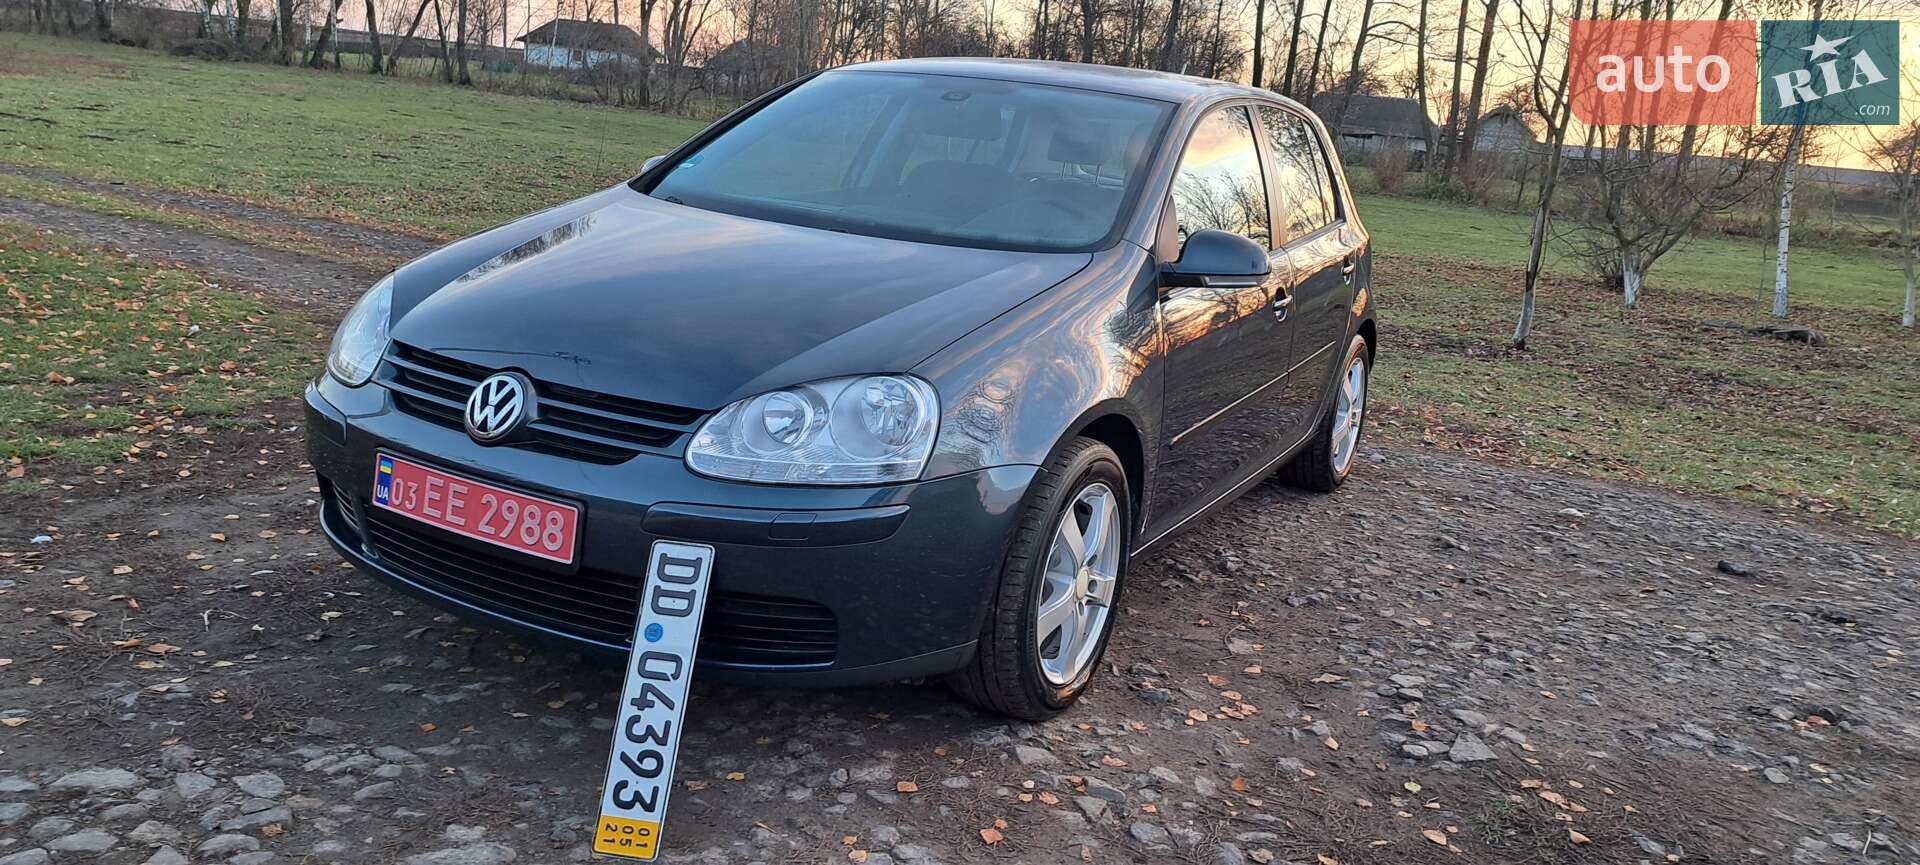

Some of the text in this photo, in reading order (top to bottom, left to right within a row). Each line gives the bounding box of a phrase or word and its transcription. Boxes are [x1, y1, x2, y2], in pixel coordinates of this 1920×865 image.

[466, 375, 524, 435] VW
[377, 484, 389, 501] UA
[478, 493, 564, 552] 2988
[612, 552, 703, 813] DD 04393
